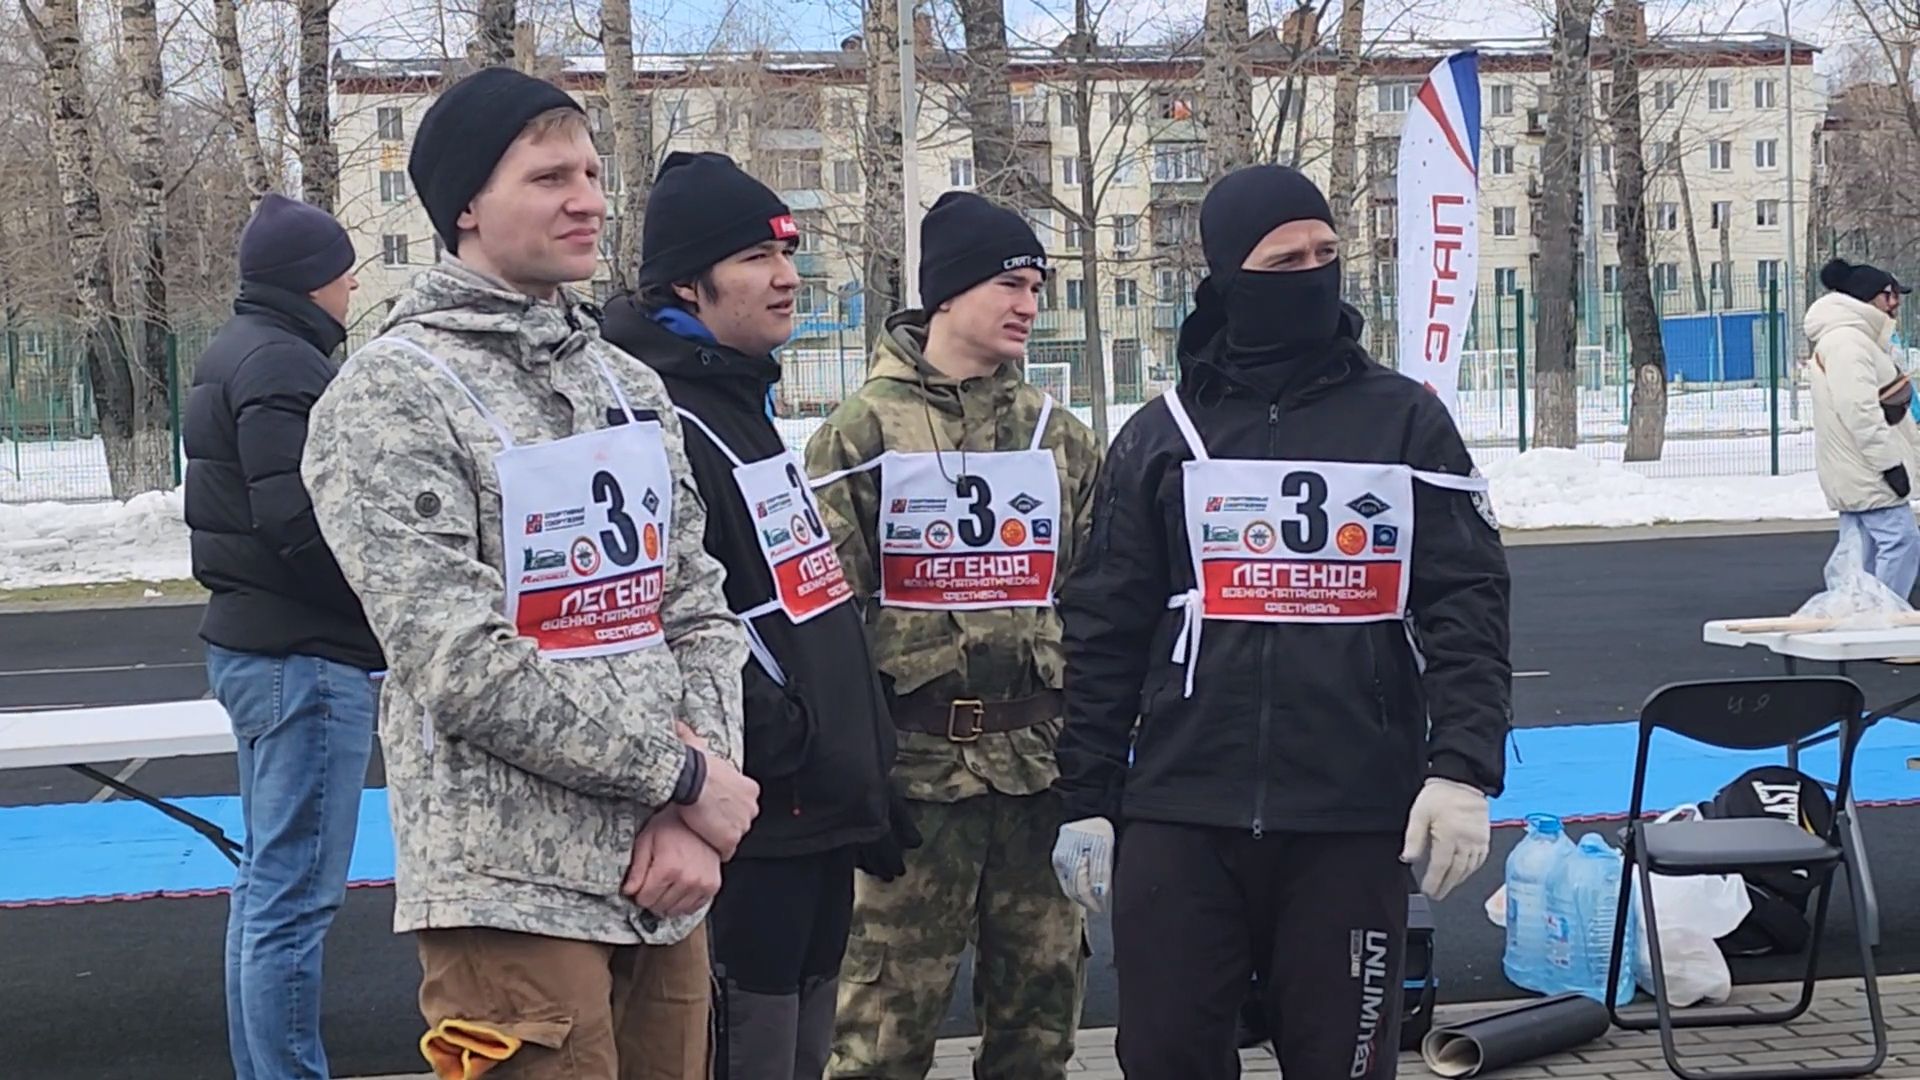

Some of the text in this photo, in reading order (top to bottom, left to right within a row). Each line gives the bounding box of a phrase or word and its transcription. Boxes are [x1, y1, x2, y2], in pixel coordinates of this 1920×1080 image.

[1425, 195, 1464, 362] ЭТАП
[591, 470, 640, 567] 3
[956, 474, 996, 547] 3
[1281, 471, 1329, 554] 3
[915, 554, 1030, 579] ЛЕГЕНДА
[1232, 562, 1367, 588] ЛЕГЕНДА
[560, 571, 660, 618] ЛЕГЕНД
[1221, 585, 1378, 600] ВОЕННО-ПАТРИОТИЧЕСКИЙ
[1264, 602, 1341, 615] ФЕСТИВАЛЬ
